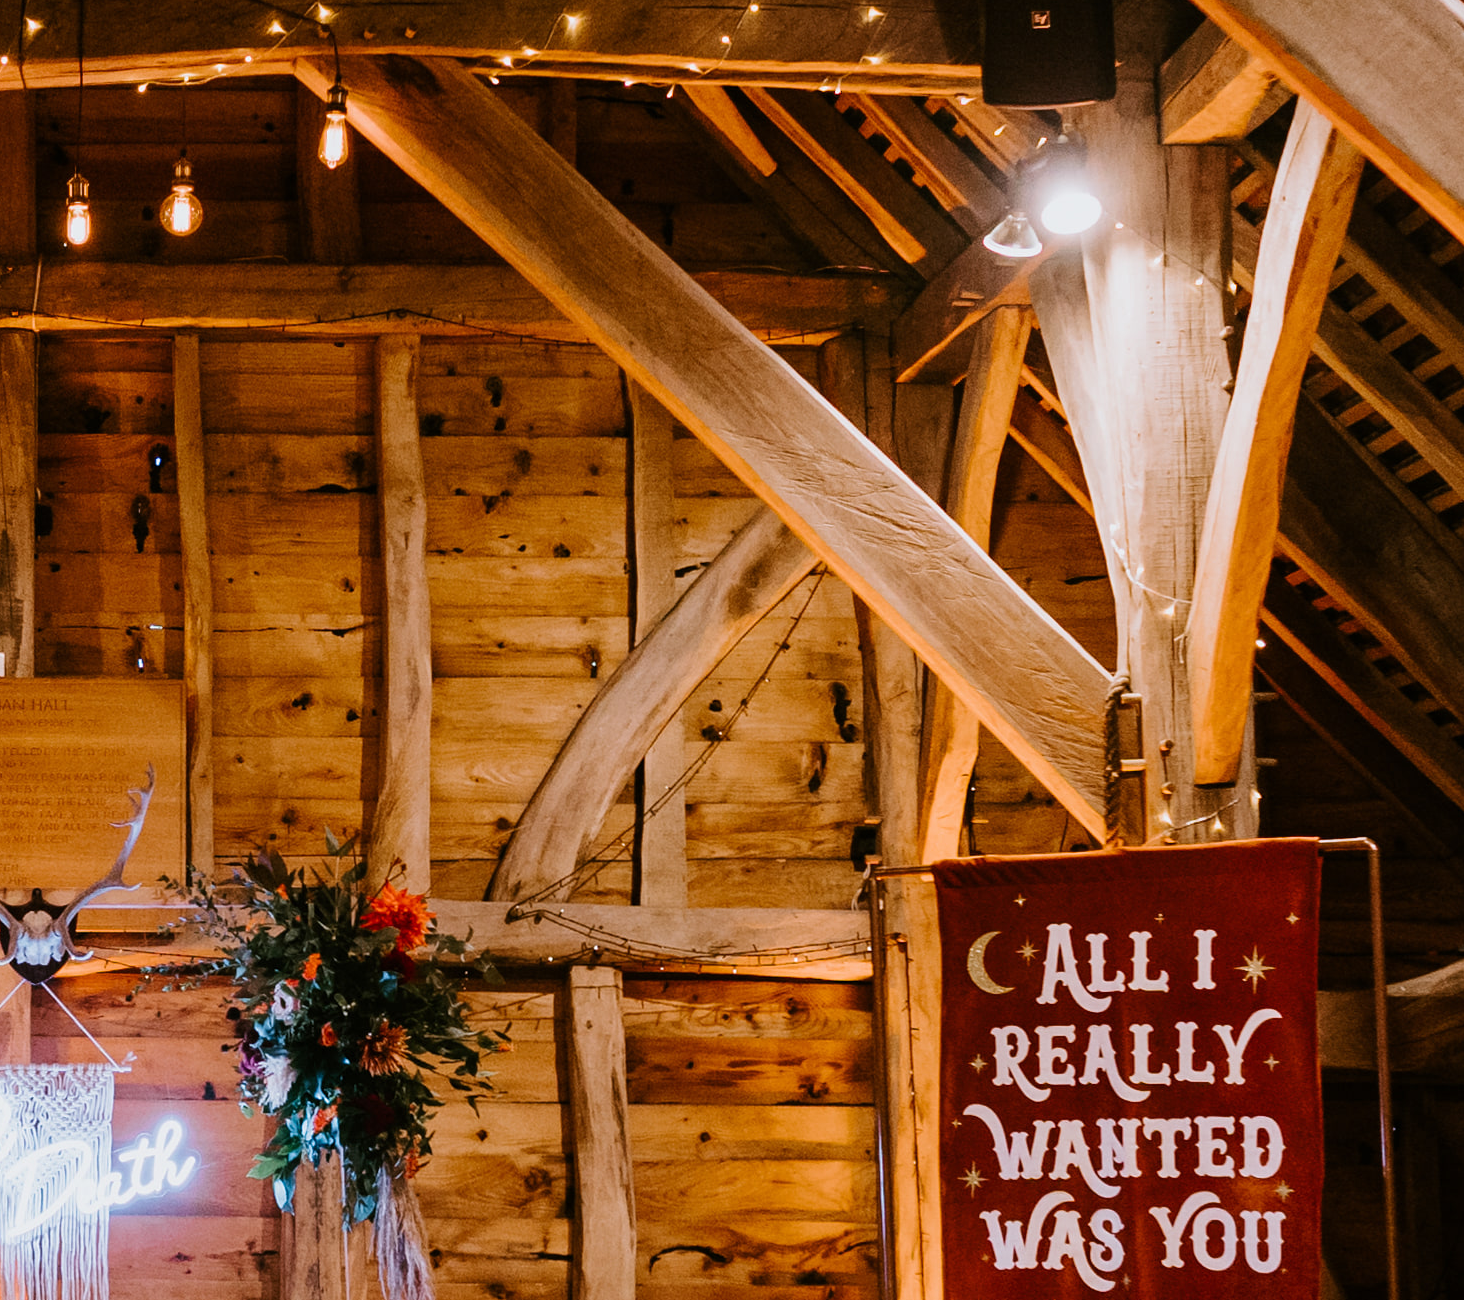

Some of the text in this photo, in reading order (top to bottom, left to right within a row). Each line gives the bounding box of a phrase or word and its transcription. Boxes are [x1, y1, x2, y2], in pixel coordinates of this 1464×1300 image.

[31, 699, 74, 711] HALL
[1037, 923, 1217, 1013] ALL I
[991, 1009, 1283, 1103] REALLY
[5, 1119, 196, 1242] Death
[963, 1104, 1286, 1198] WANTED
[979, 1191, 1287, 1292] WAS YOU
